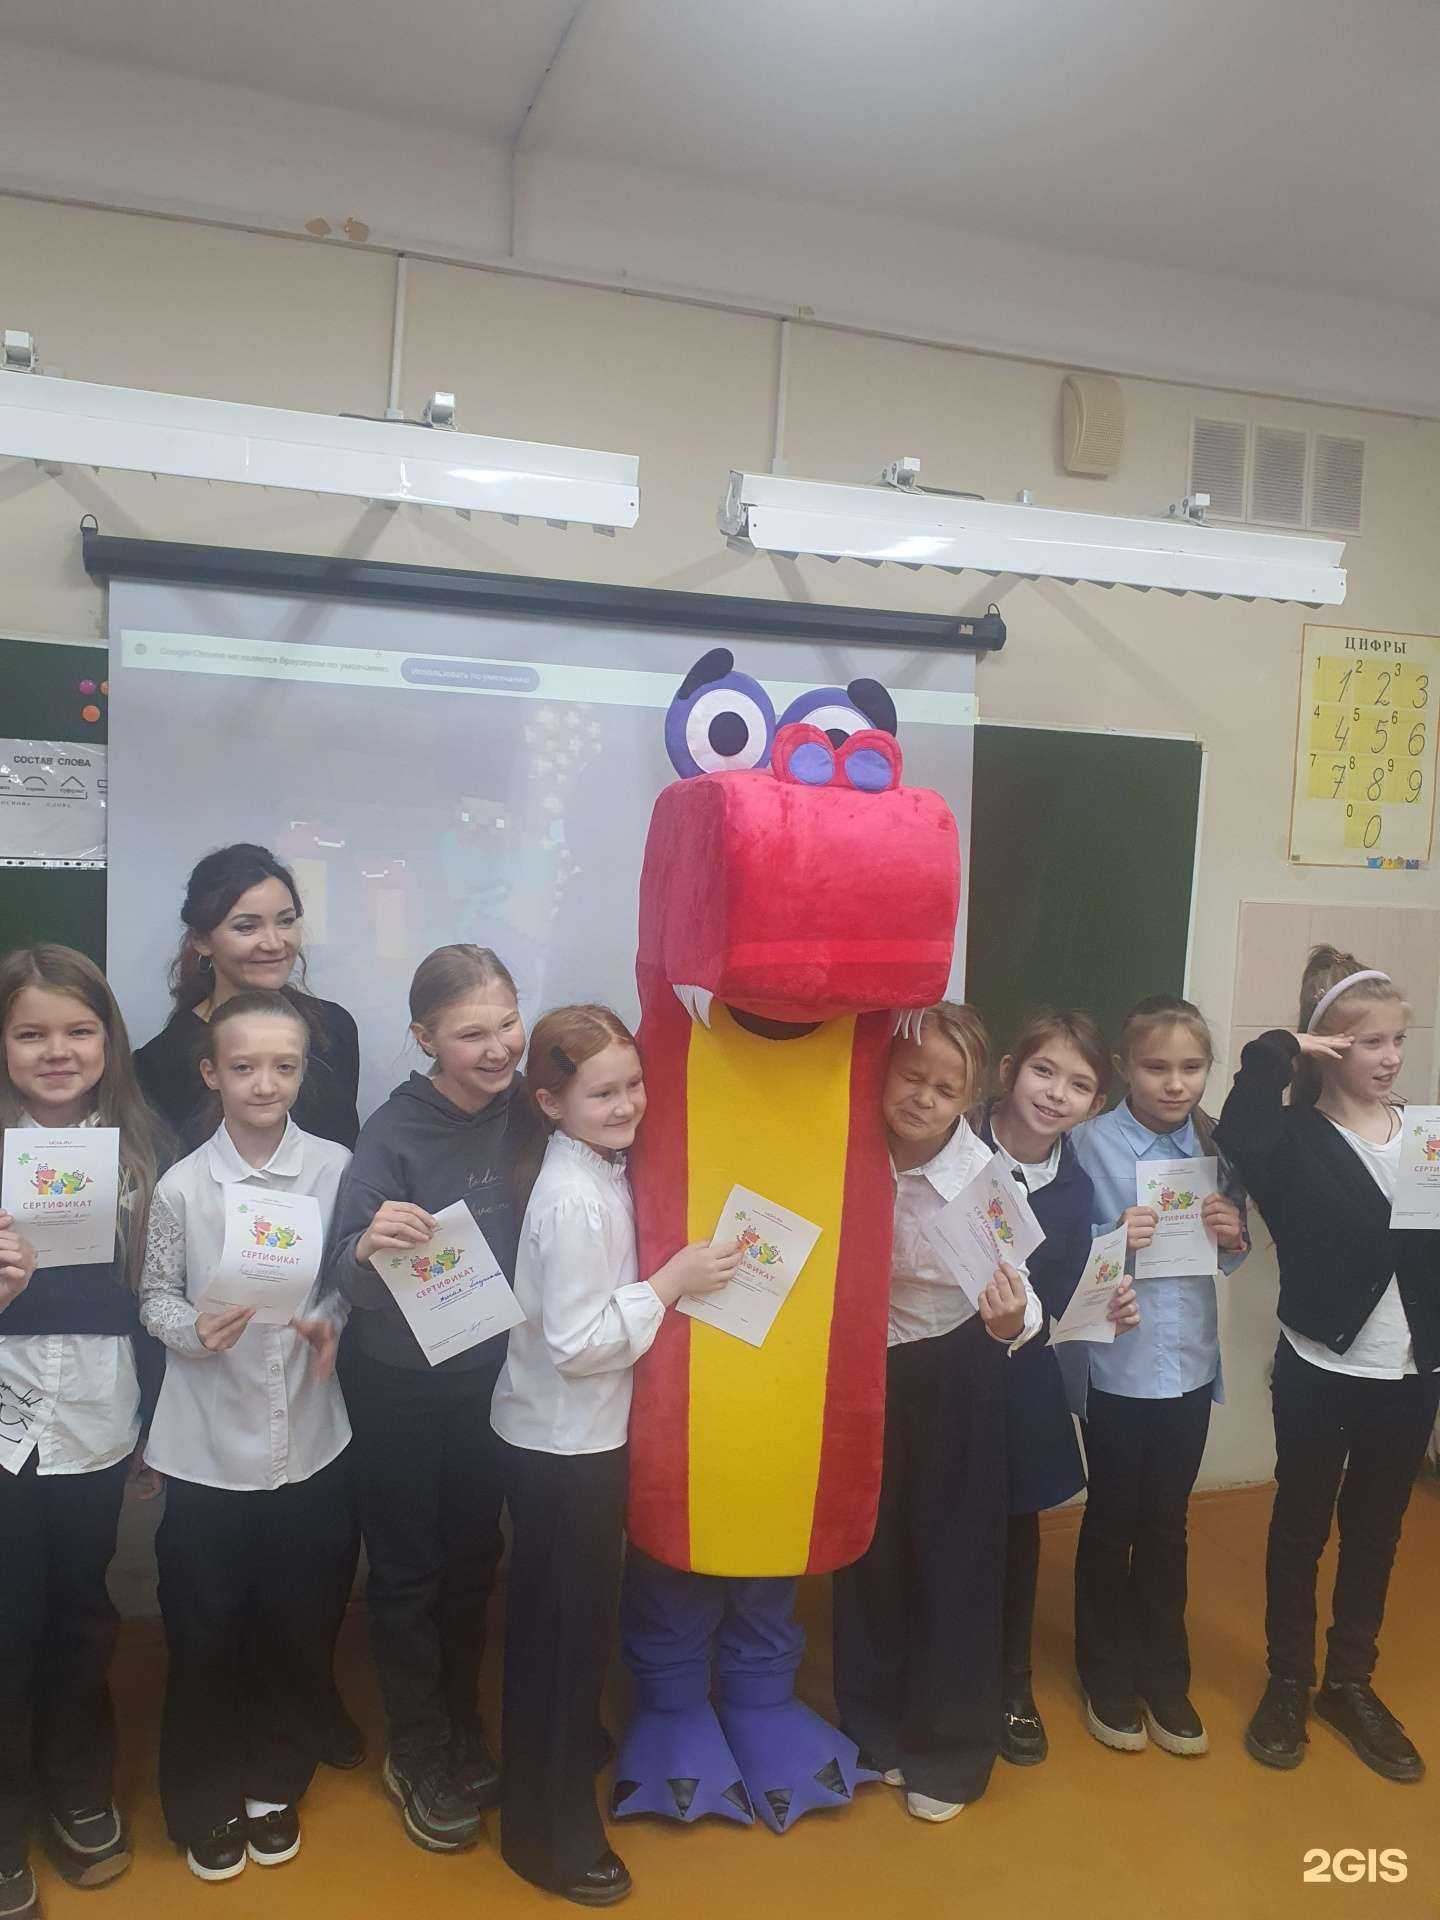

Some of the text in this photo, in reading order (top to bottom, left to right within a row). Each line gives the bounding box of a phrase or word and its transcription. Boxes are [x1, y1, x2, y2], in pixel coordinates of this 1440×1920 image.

[1344, 636, 1408, 654] ЦИФРЫ
[1316, 656, 1429, 709] 1 1 2 2 3 3
[1313, 705, 1426, 756] 4 4 5 5 6 6
[13, 755, 92, 768] СОСТАВ СЛОВА
[1309, 753, 1423, 803] 7 7 8 8 9 9
[1346, 803, 1382, 848] 0 0
[1413, 1164, 1440, 1173] СЕРТИ
[22, 1199, 93, 1210] СЕРТИФИКАТ
[1160, 1213, 1199, 1222] РТИФИКАТ
[241, 1249, 300, 1265] СЕРТИФИКАТ
[415, 1266, 476, 1300] СЕРТИФИКАТ
